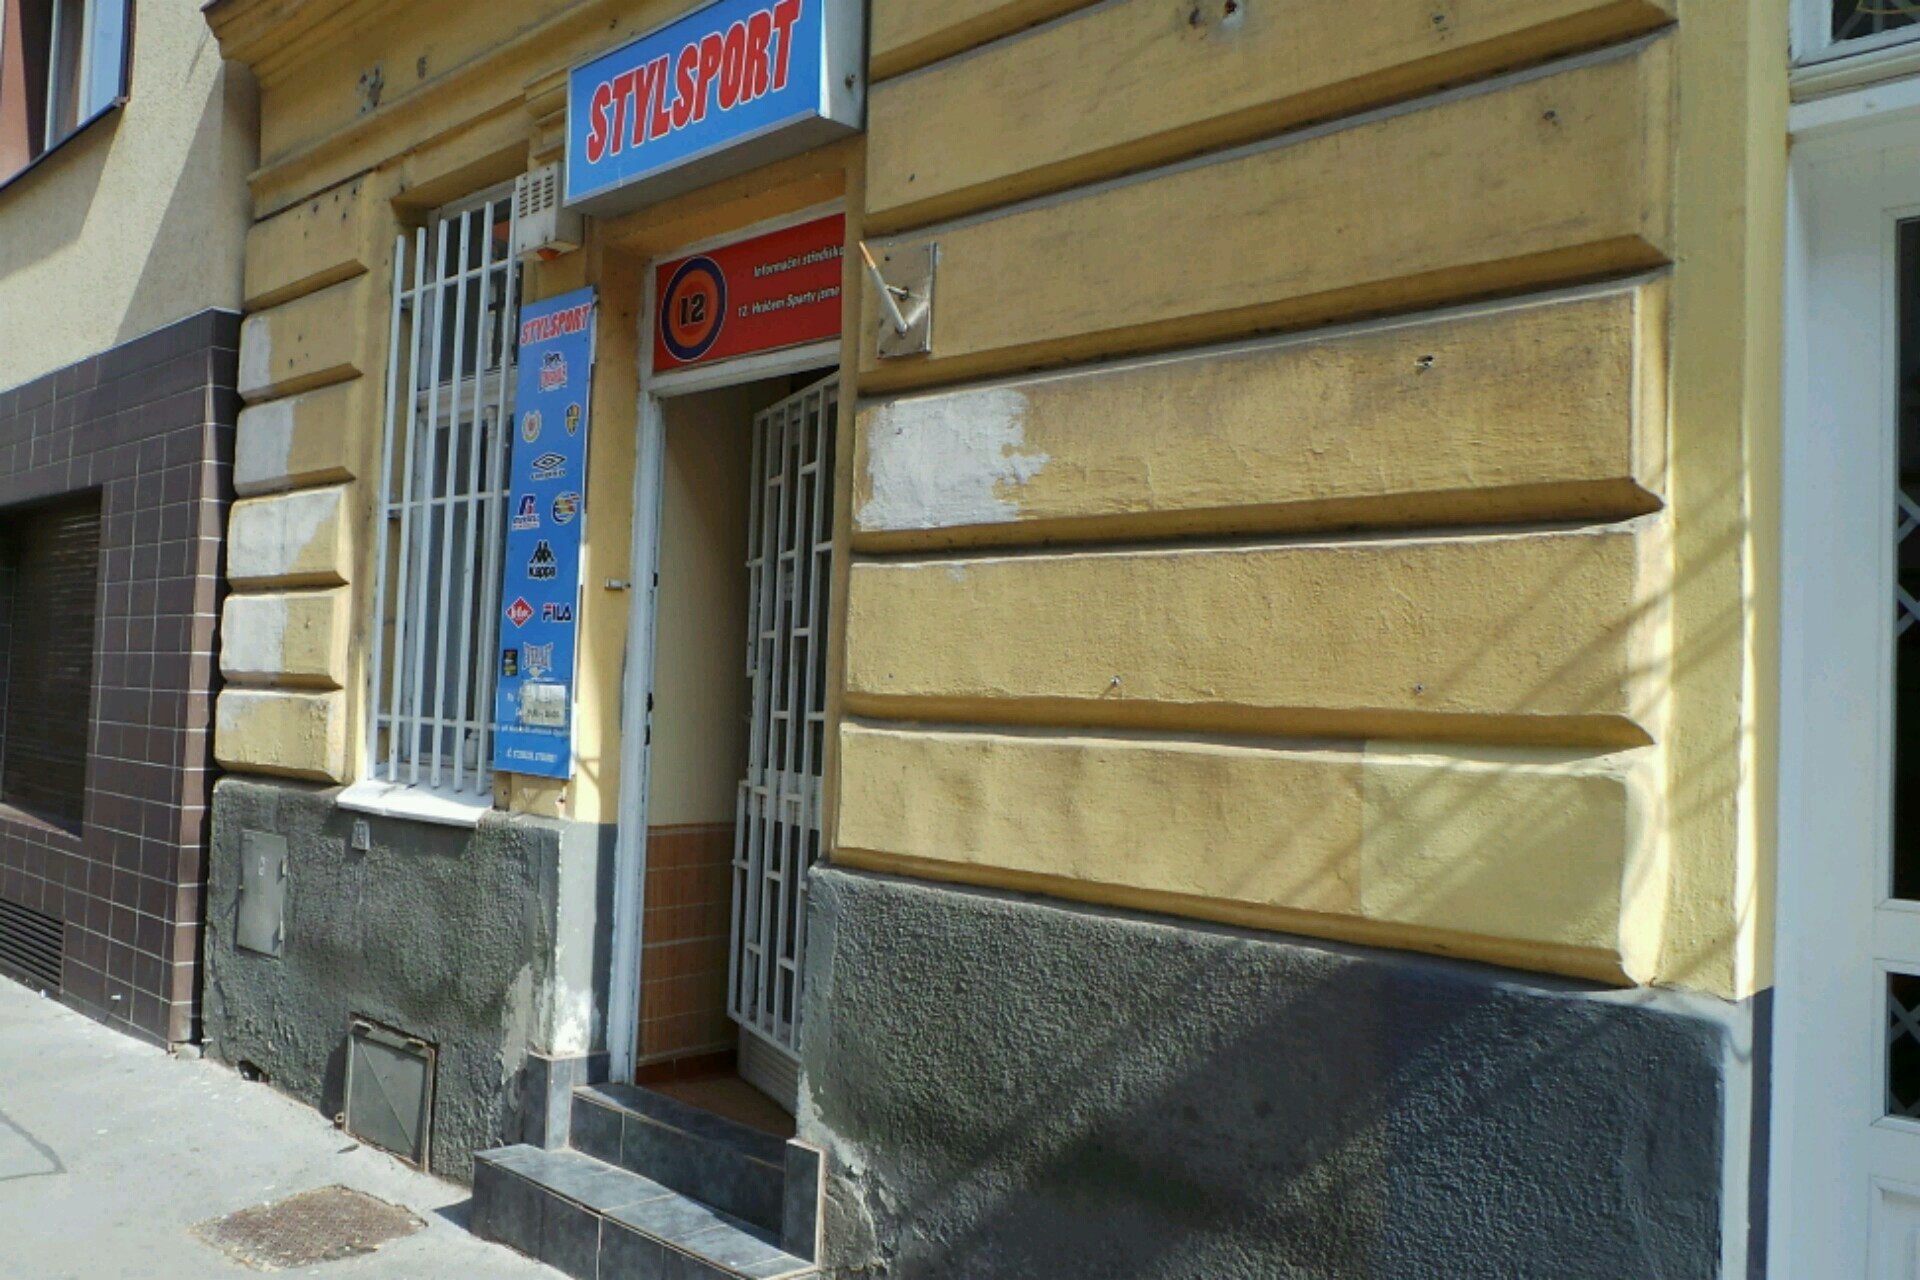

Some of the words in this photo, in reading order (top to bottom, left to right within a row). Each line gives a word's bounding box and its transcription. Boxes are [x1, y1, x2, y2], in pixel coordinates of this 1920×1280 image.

[586, 0, 801, 164] STYLSPORT
[520, 302, 591, 346] STYLSPORT
[680, 291, 706, 328] 12
[542, 603, 572, 621] FILA
